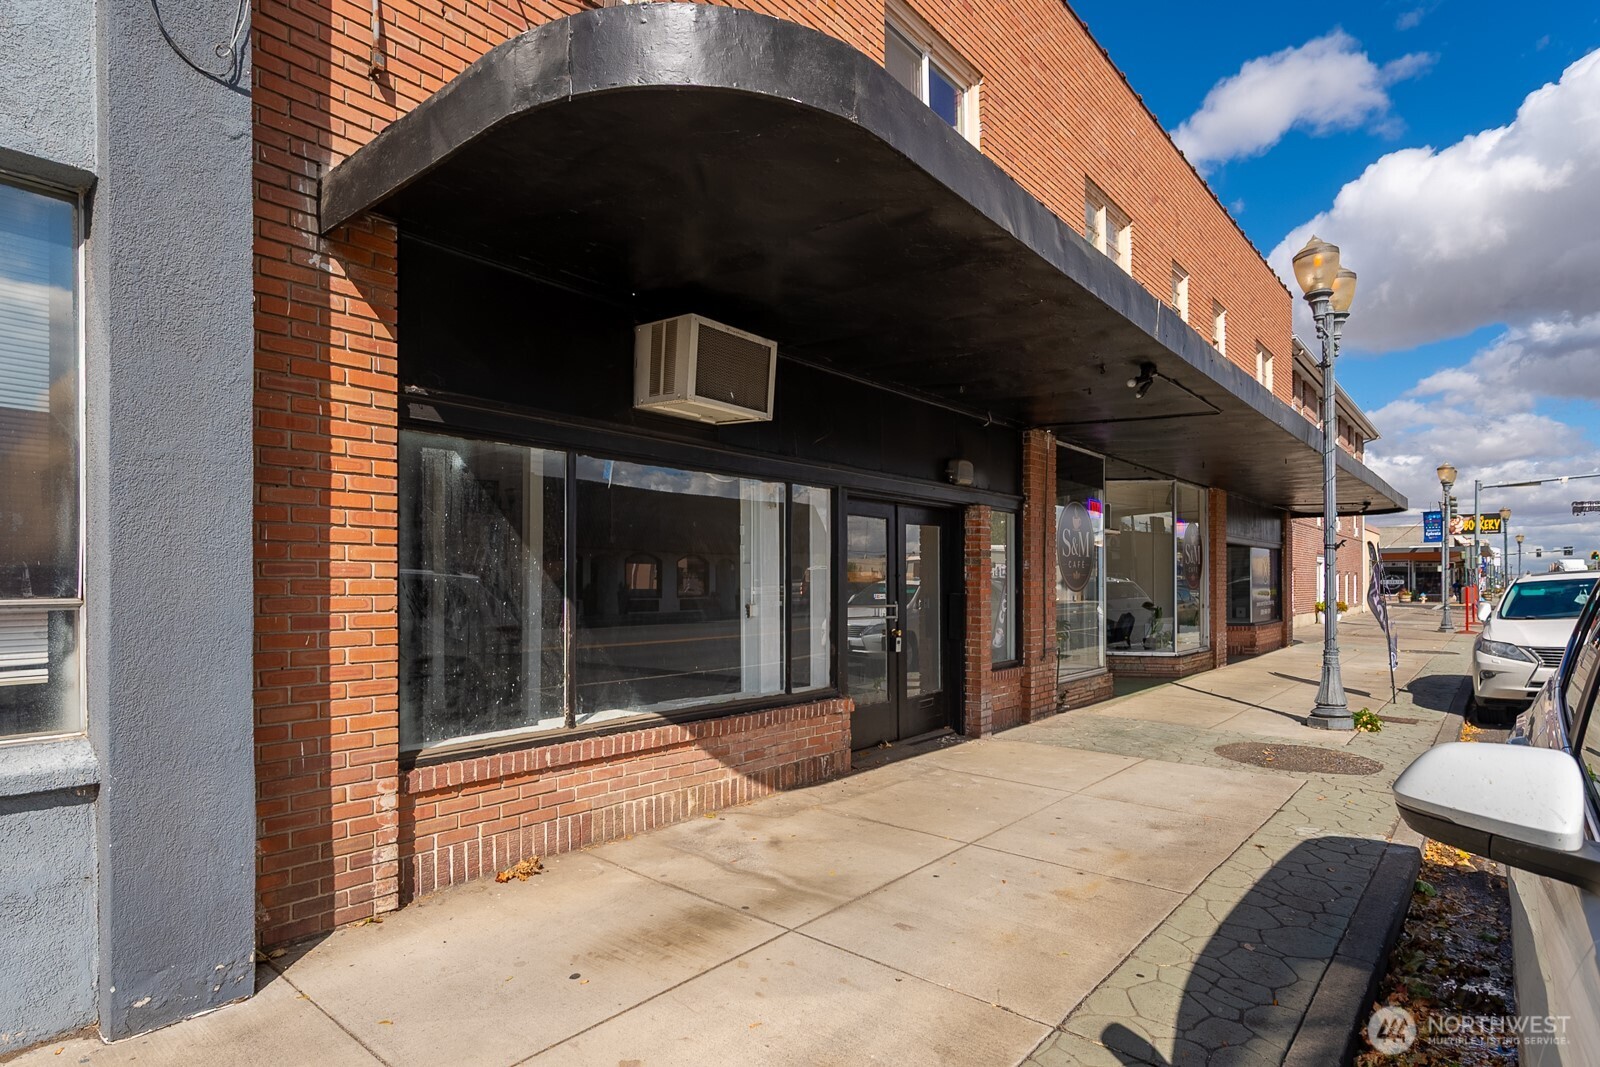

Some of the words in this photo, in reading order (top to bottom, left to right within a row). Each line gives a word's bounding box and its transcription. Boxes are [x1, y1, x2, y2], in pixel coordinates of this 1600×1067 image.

[1463, 519, 1500, 531] BOKERY
[1062, 528, 1090, 557] S&M
[1185, 544, 1200, 565] S&M
